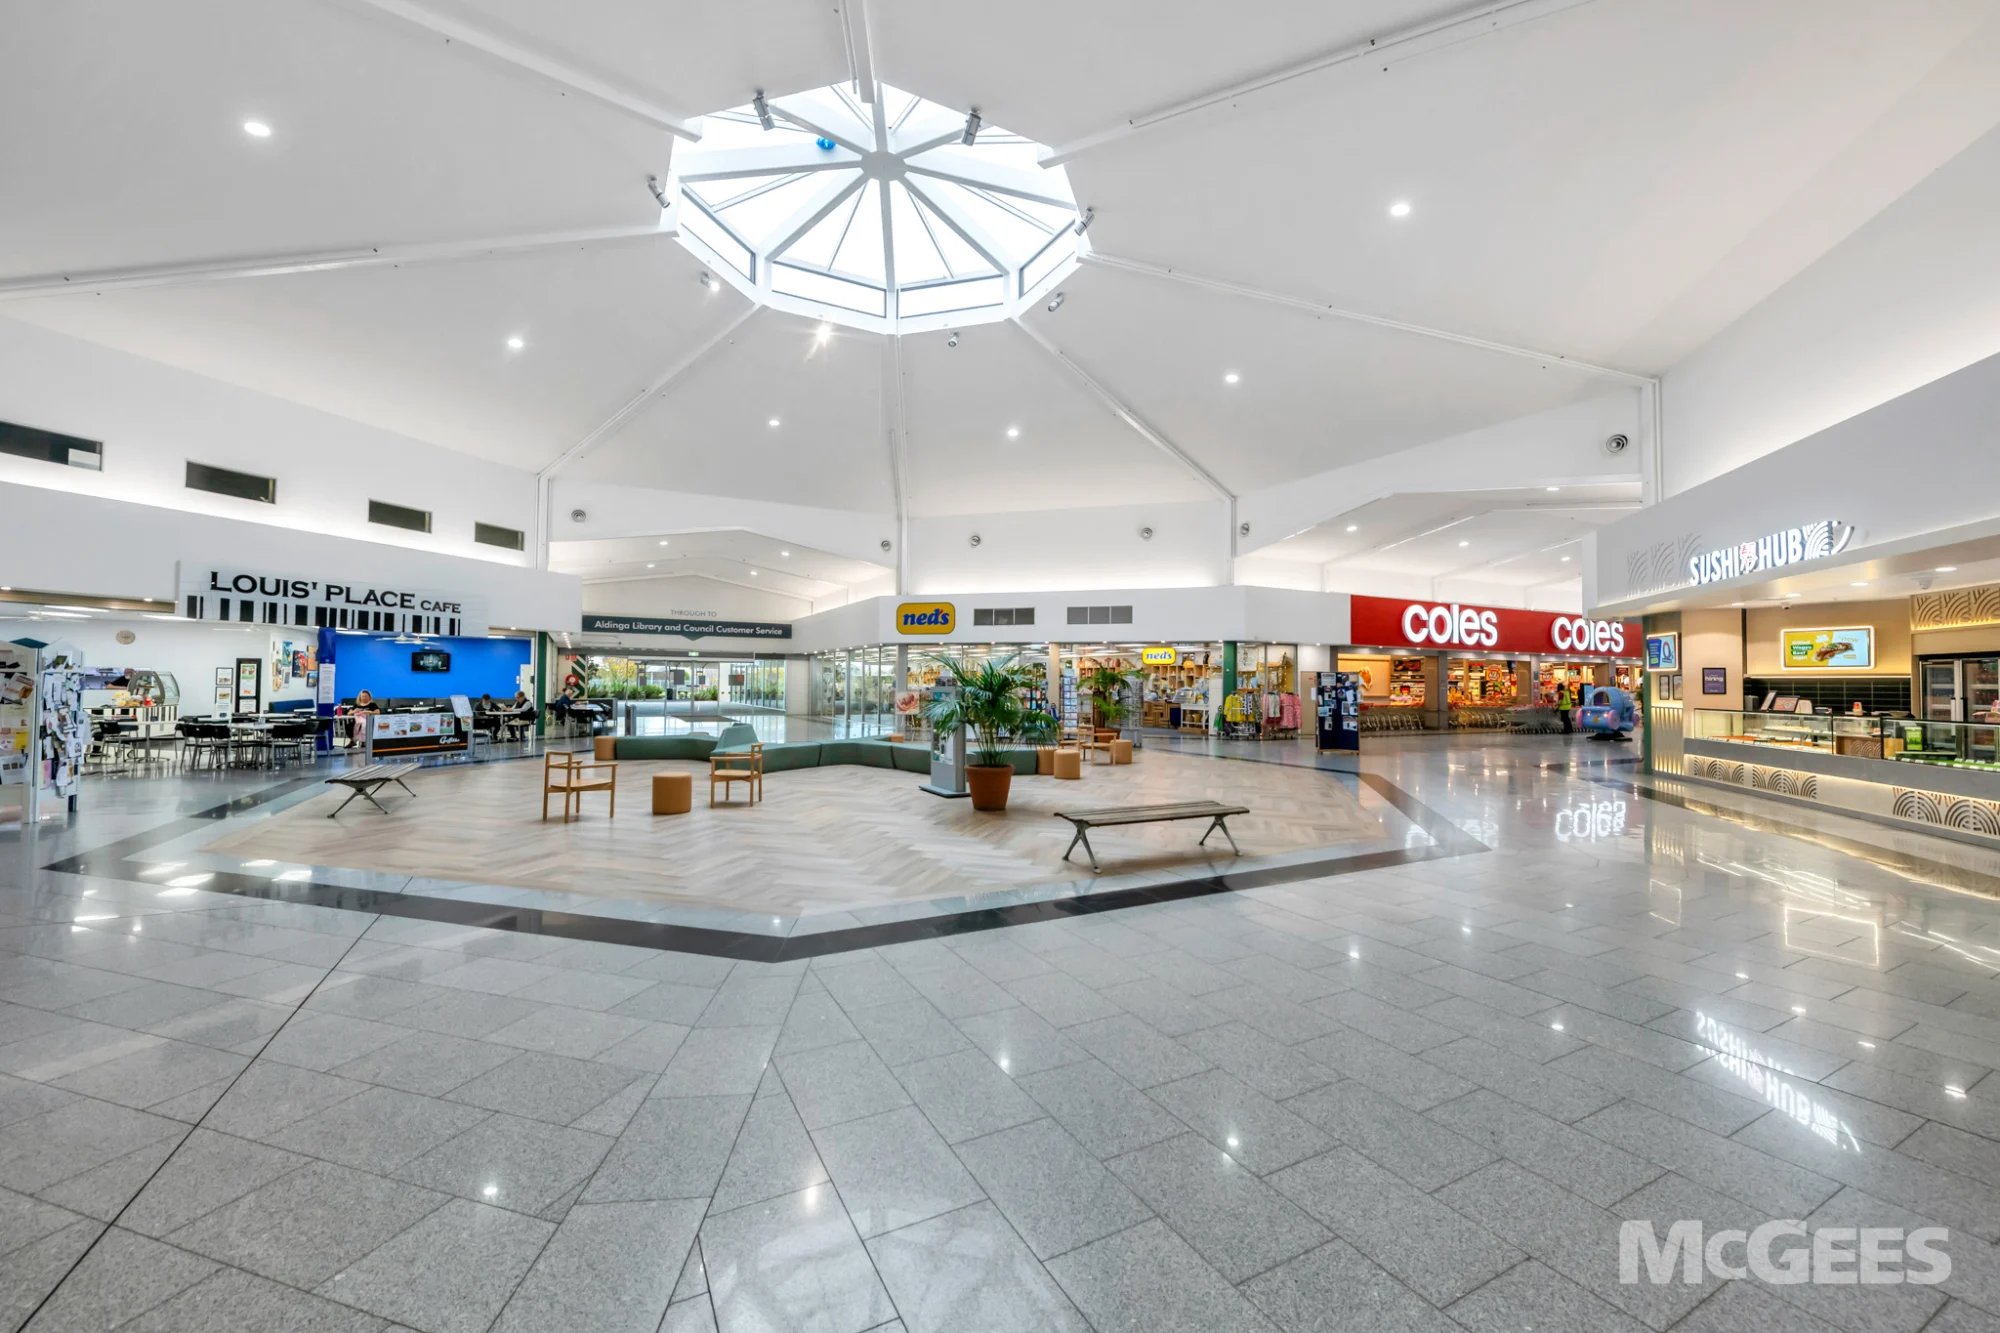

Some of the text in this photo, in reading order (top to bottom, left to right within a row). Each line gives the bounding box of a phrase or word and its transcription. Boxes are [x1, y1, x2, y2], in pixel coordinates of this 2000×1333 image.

[1689, 546, 1740, 587] SUSHI
[1758, 528, 1803, 571] HUB
[210, 571, 461, 614] LOUIS' PLACE CAFE
[670, 609, 706, 617] THROUGH
[903, 608, 950, 626] ned's
[1403, 604, 1498, 646] coles
[595, 620, 783, 635] Aldinga Library and Council Customer Service
[1552, 617, 1624, 653] coles
[1146, 650, 1172, 660] ned's
